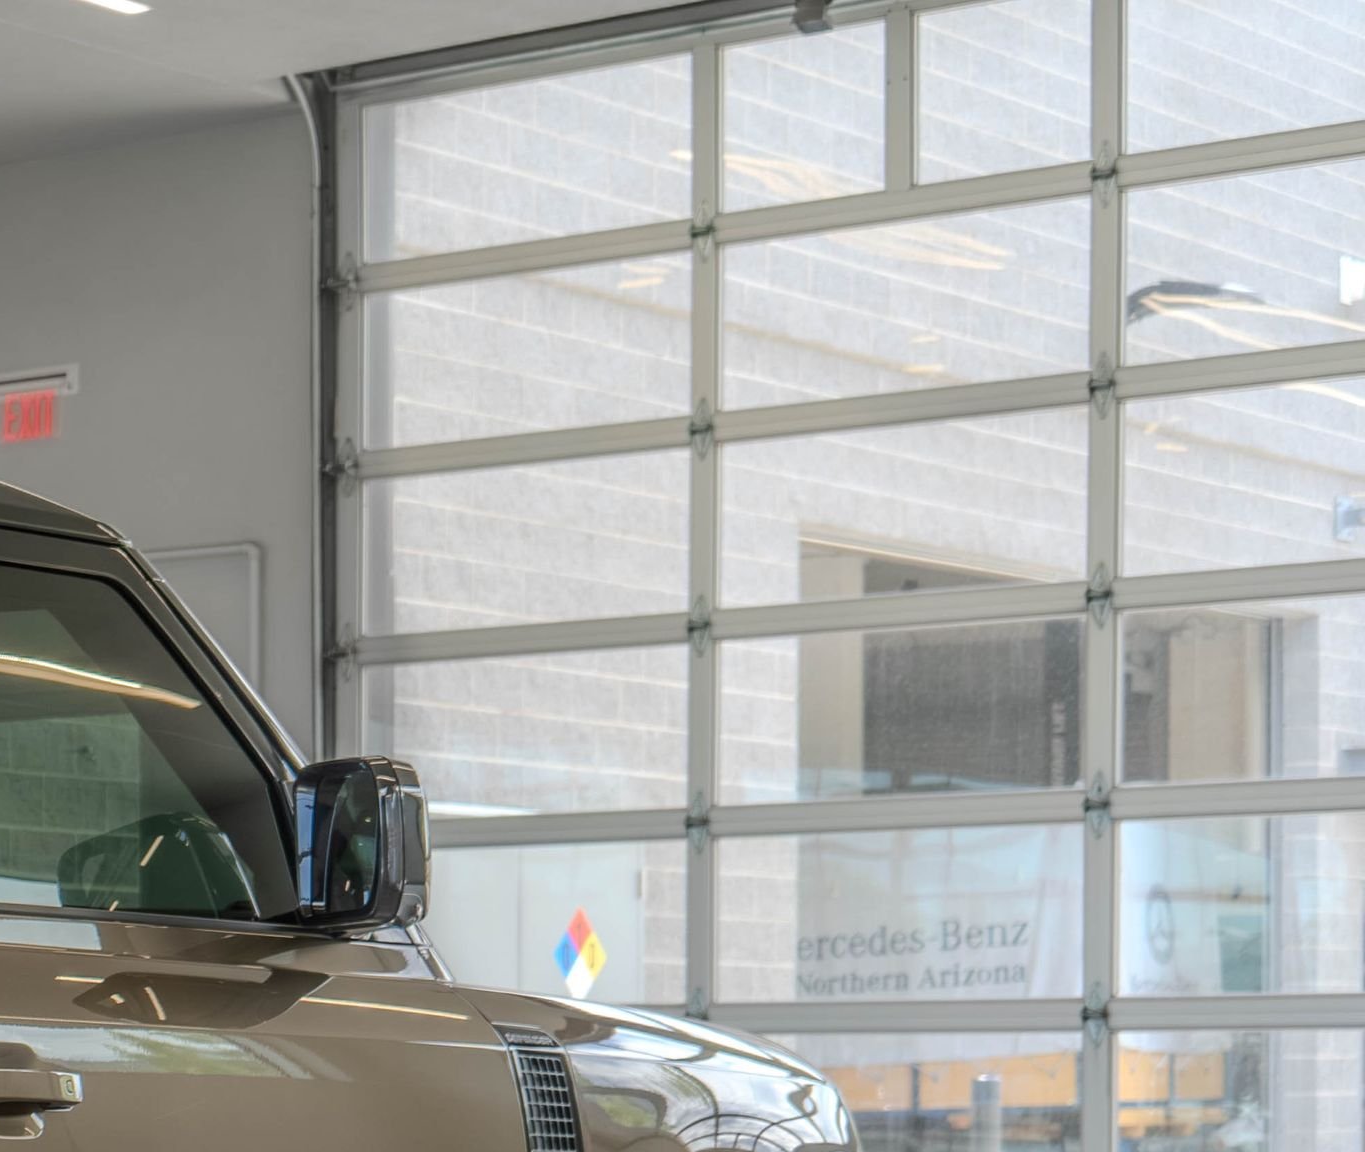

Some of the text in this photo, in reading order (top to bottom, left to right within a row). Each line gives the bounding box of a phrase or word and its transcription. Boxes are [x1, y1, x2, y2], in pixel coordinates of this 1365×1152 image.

[4, 388, 54, 443] EXIT
[796, 918, 1029, 961] ercedes-Benz
[917, 962, 1027, 991] Arizona
